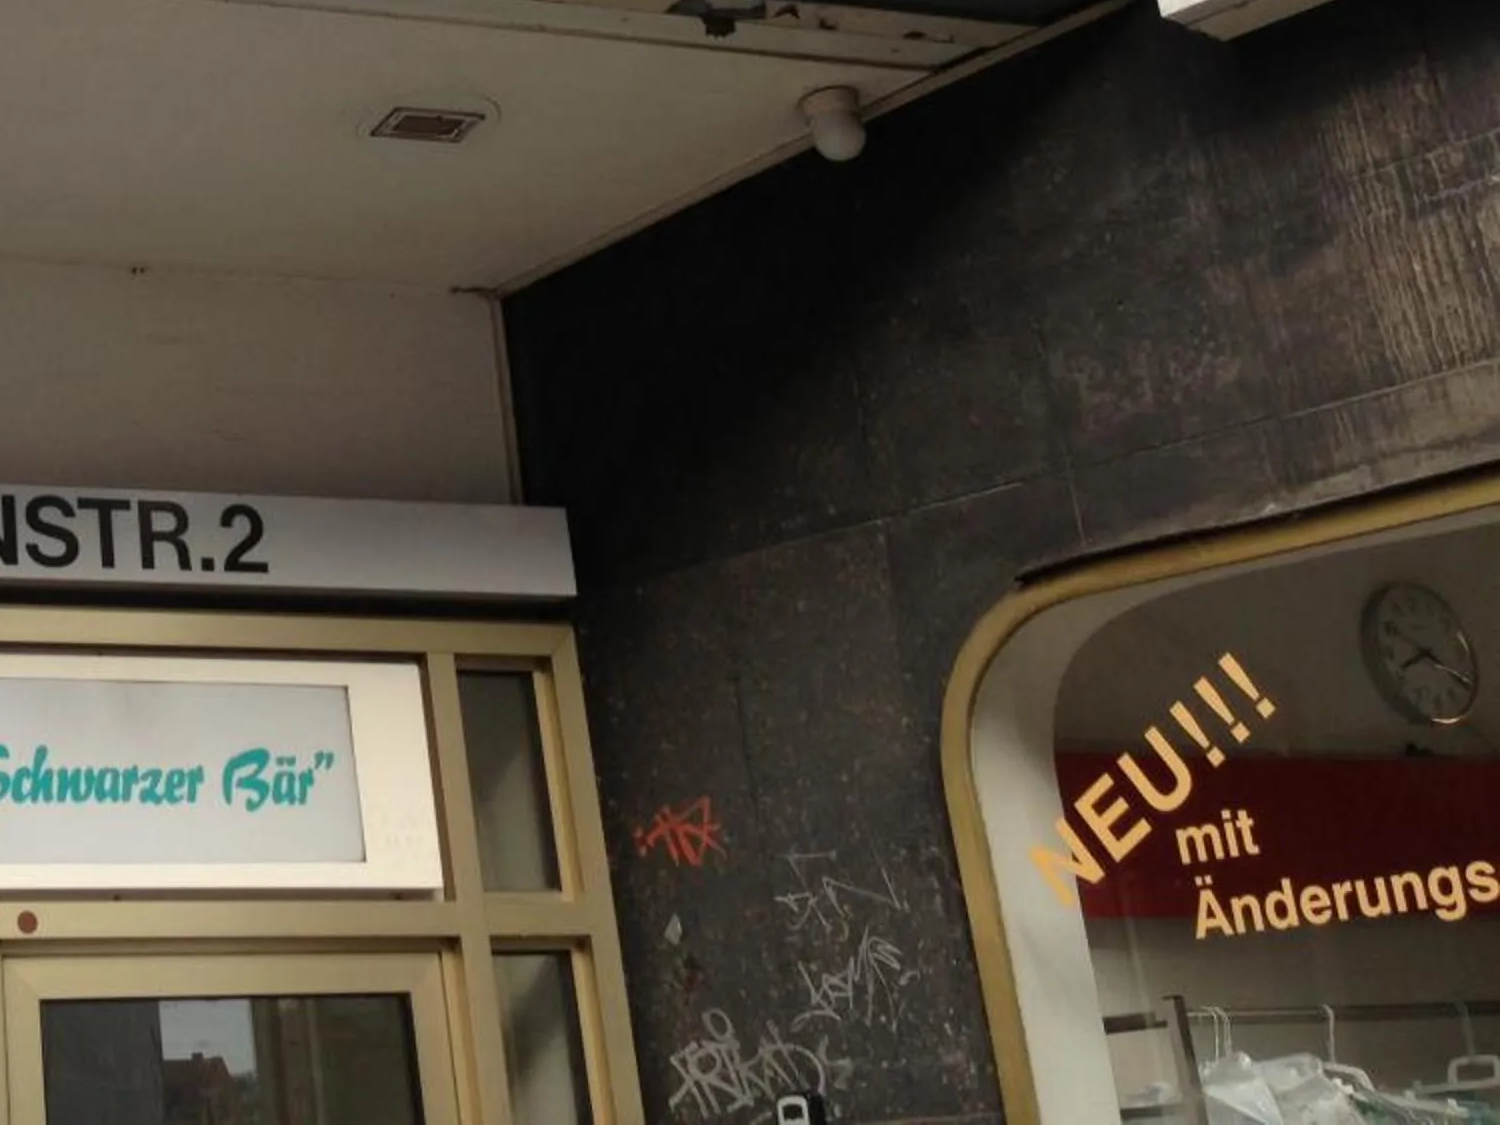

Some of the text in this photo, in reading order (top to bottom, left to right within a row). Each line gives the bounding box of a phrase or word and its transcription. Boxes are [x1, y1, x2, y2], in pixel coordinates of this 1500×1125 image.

[1028, 651, 1277, 908] NEU!!!
[1175, 809, 1260, 865] mit
[1195, 859, 1500, 939] Änderungs
